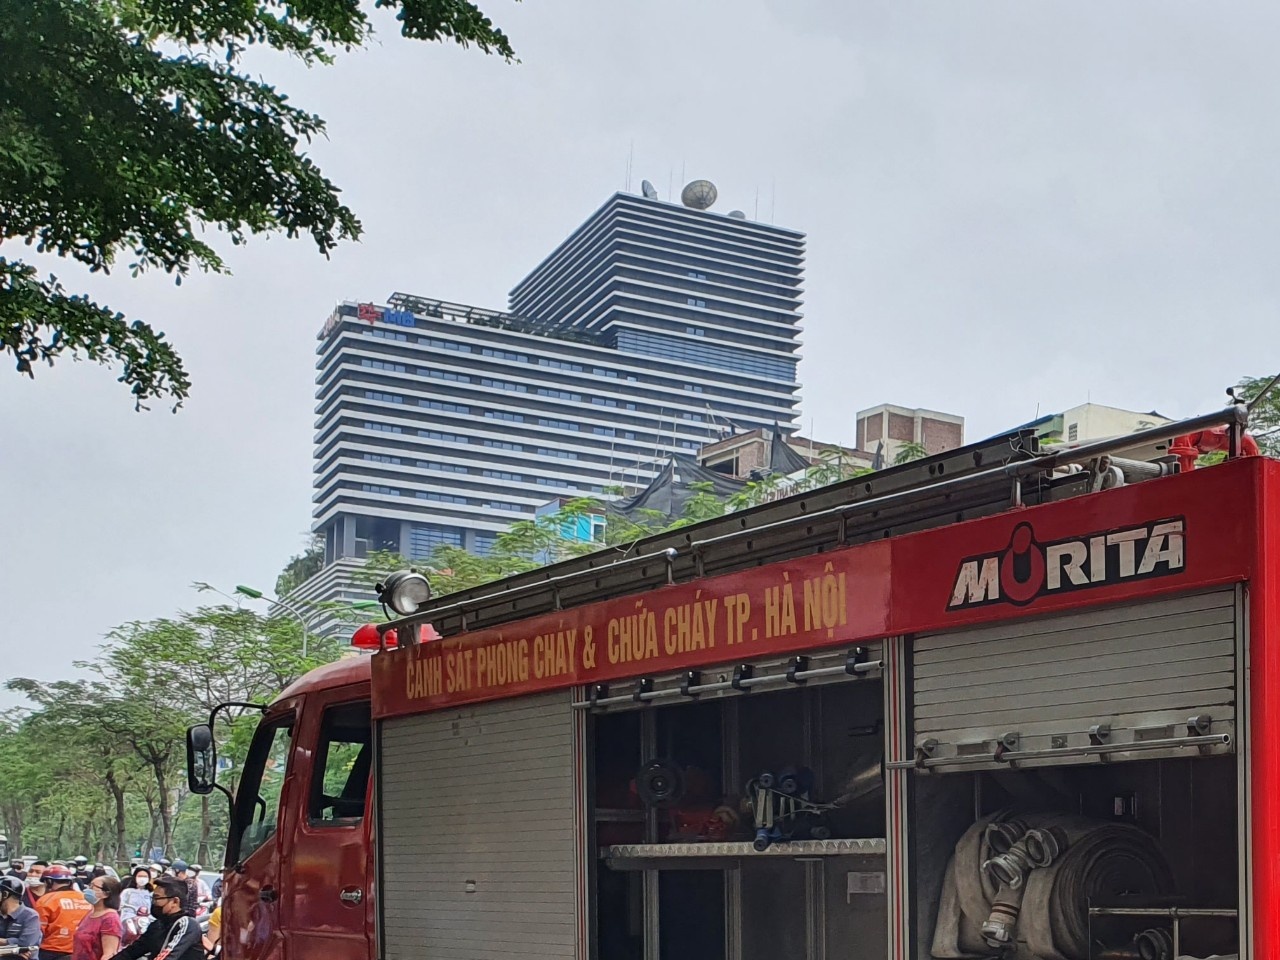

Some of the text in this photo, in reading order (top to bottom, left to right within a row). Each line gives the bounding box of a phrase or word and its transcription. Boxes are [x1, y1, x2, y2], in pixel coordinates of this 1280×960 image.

[949, 520, 1185, 607] MORITA
[446, 643, 472, 693] SÁT
[477, 632, 529, 688] PHÒNG
[533, 620, 577, 680] CHÁY
[582, 625, 596, 669] &
[607, 598, 659, 665] CHỮA
[664, 589, 718, 656] CHÁY
[724, 592, 758, 646] TP.
[765, 571, 797, 638] HÀ
[803, 561, 847, 639] NỘI
